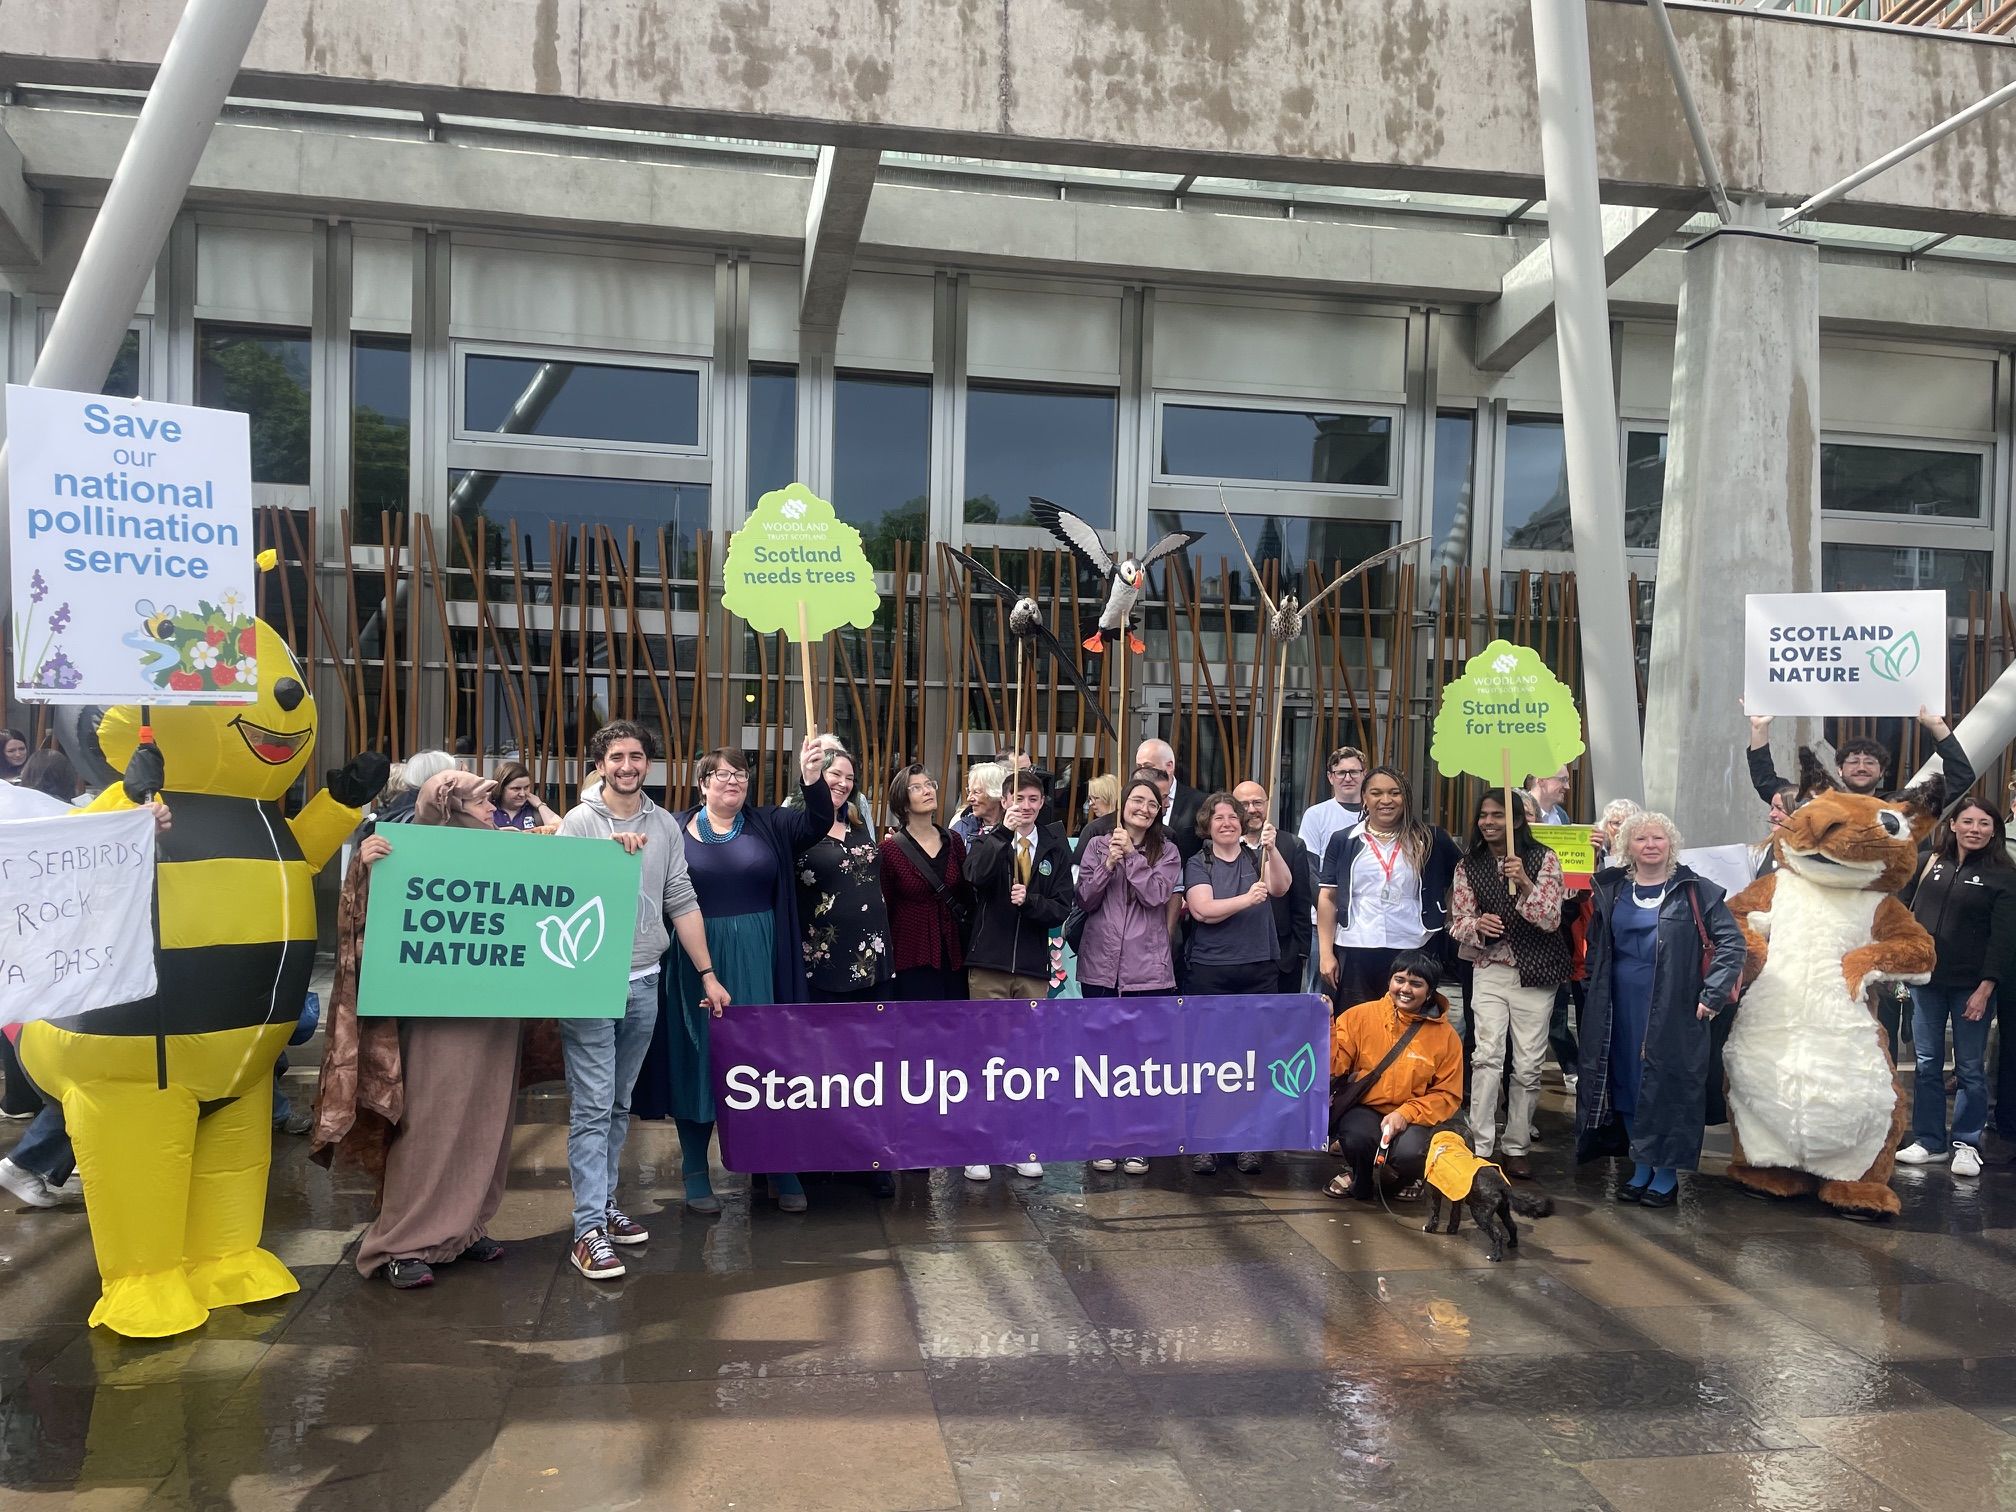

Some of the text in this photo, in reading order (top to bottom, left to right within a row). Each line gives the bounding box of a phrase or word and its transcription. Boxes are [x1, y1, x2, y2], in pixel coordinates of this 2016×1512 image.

[84, 403, 182, 443] Save
[113, 449, 156, 467] our
[54, 472, 213, 509] national
[28, 506, 239, 546] pollination
[762, 522, 829, 532] WOODLAND
[790, 533, 827, 541] SCOTLAND
[63, 547, 209, 579] service
[754, 545, 842, 563] Scotland
[744, 567, 856, 584] needs trees
[1769, 626, 1894, 642] SCOTLAND
[1769, 647, 1842, 662] LOVES
[1473, 675, 1538, 686] WOODLAND
[1769, 667, 1860, 682] NATURE
[1463, 698, 1549, 718] Stand up
[1466, 719, 1546, 734] for trees
[28, 842, 143, 879] SEABIRDS
[406, 876, 575, 908] SCOTLAND
[12, 890, 92, 935] ROCK
[402, 908, 505, 936] LOVES
[399, 940, 527, 967] NATURE
[724, 1050, 1257, 1115] Stand Up for Nature!
